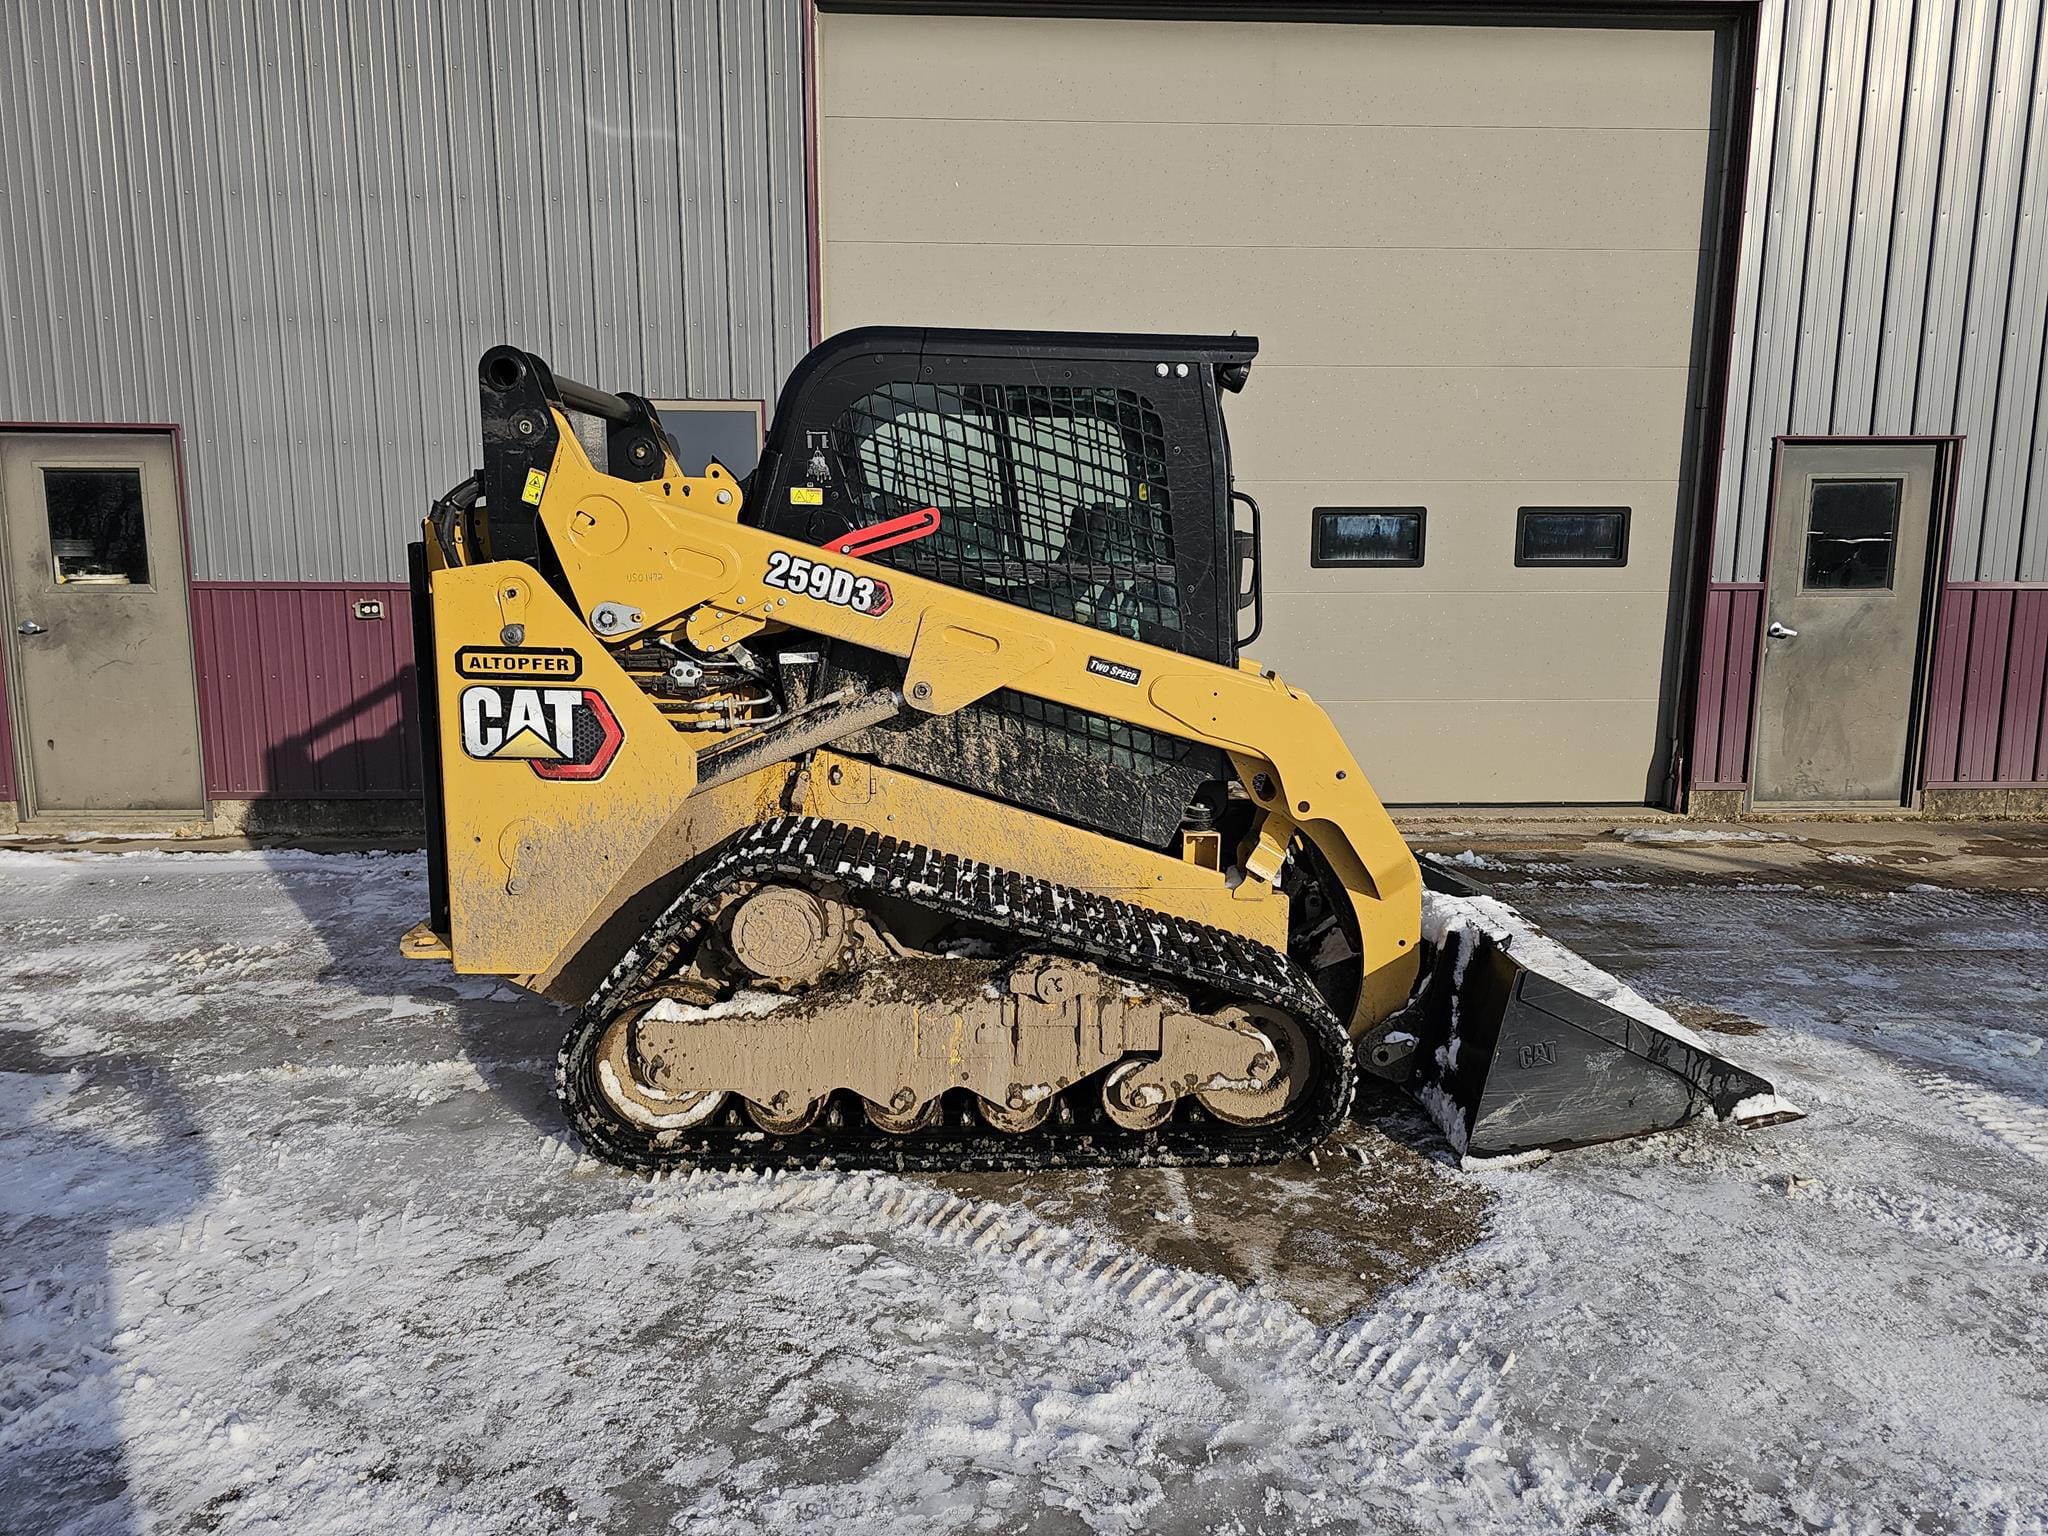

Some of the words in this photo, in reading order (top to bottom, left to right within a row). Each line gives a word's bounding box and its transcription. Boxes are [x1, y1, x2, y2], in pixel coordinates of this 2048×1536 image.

[764, 551, 876, 612] 259D3
[469, 655, 569, 671] ALTOPFER
[1110, 666, 1137, 680] SPEED
[463, 686, 582, 759] CAT
[1520, 1041, 1557, 1068] CAT
